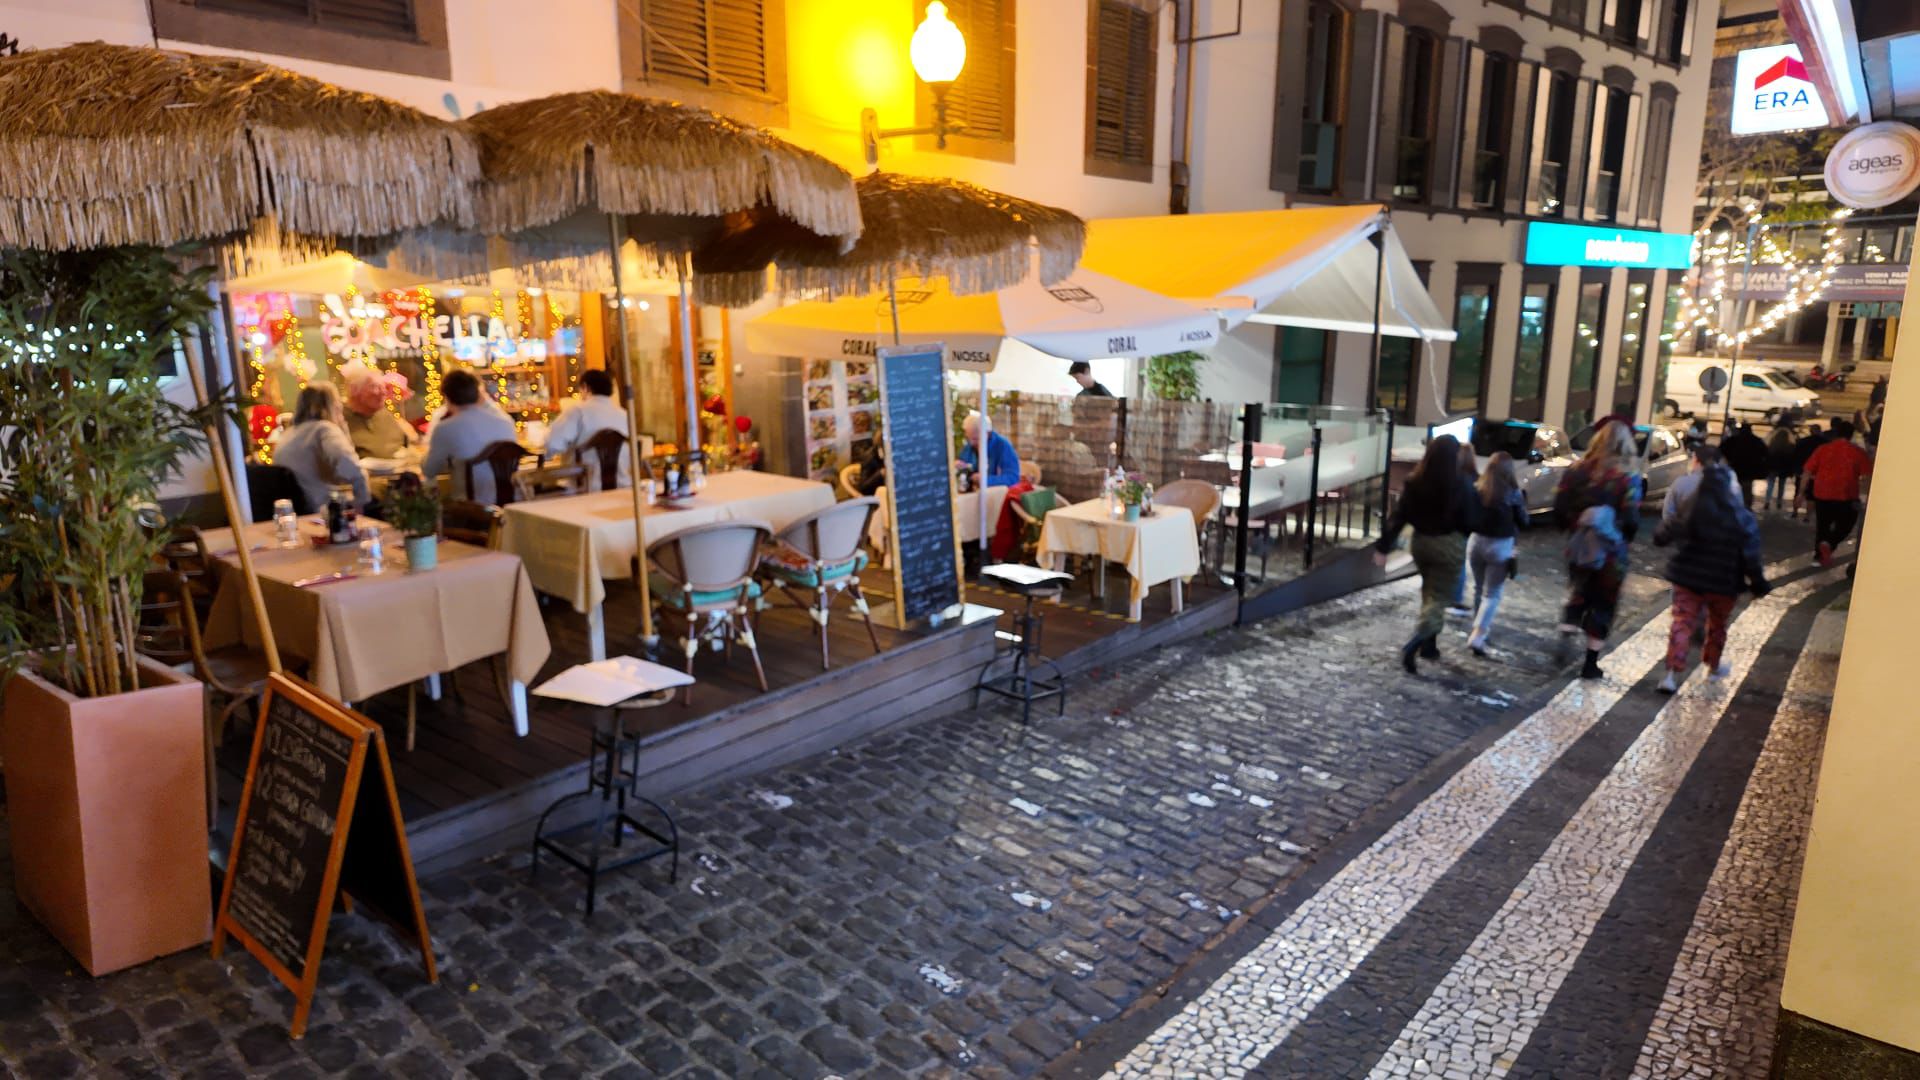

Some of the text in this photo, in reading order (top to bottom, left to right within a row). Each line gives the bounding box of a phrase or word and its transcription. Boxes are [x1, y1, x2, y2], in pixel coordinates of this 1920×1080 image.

[1754, 89, 1809, 110] ERA
[1848, 154, 1903, 174] ageas
[1108, 336, 1137, 354] CORAL
[952, 350, 992, 363] NOSSA
